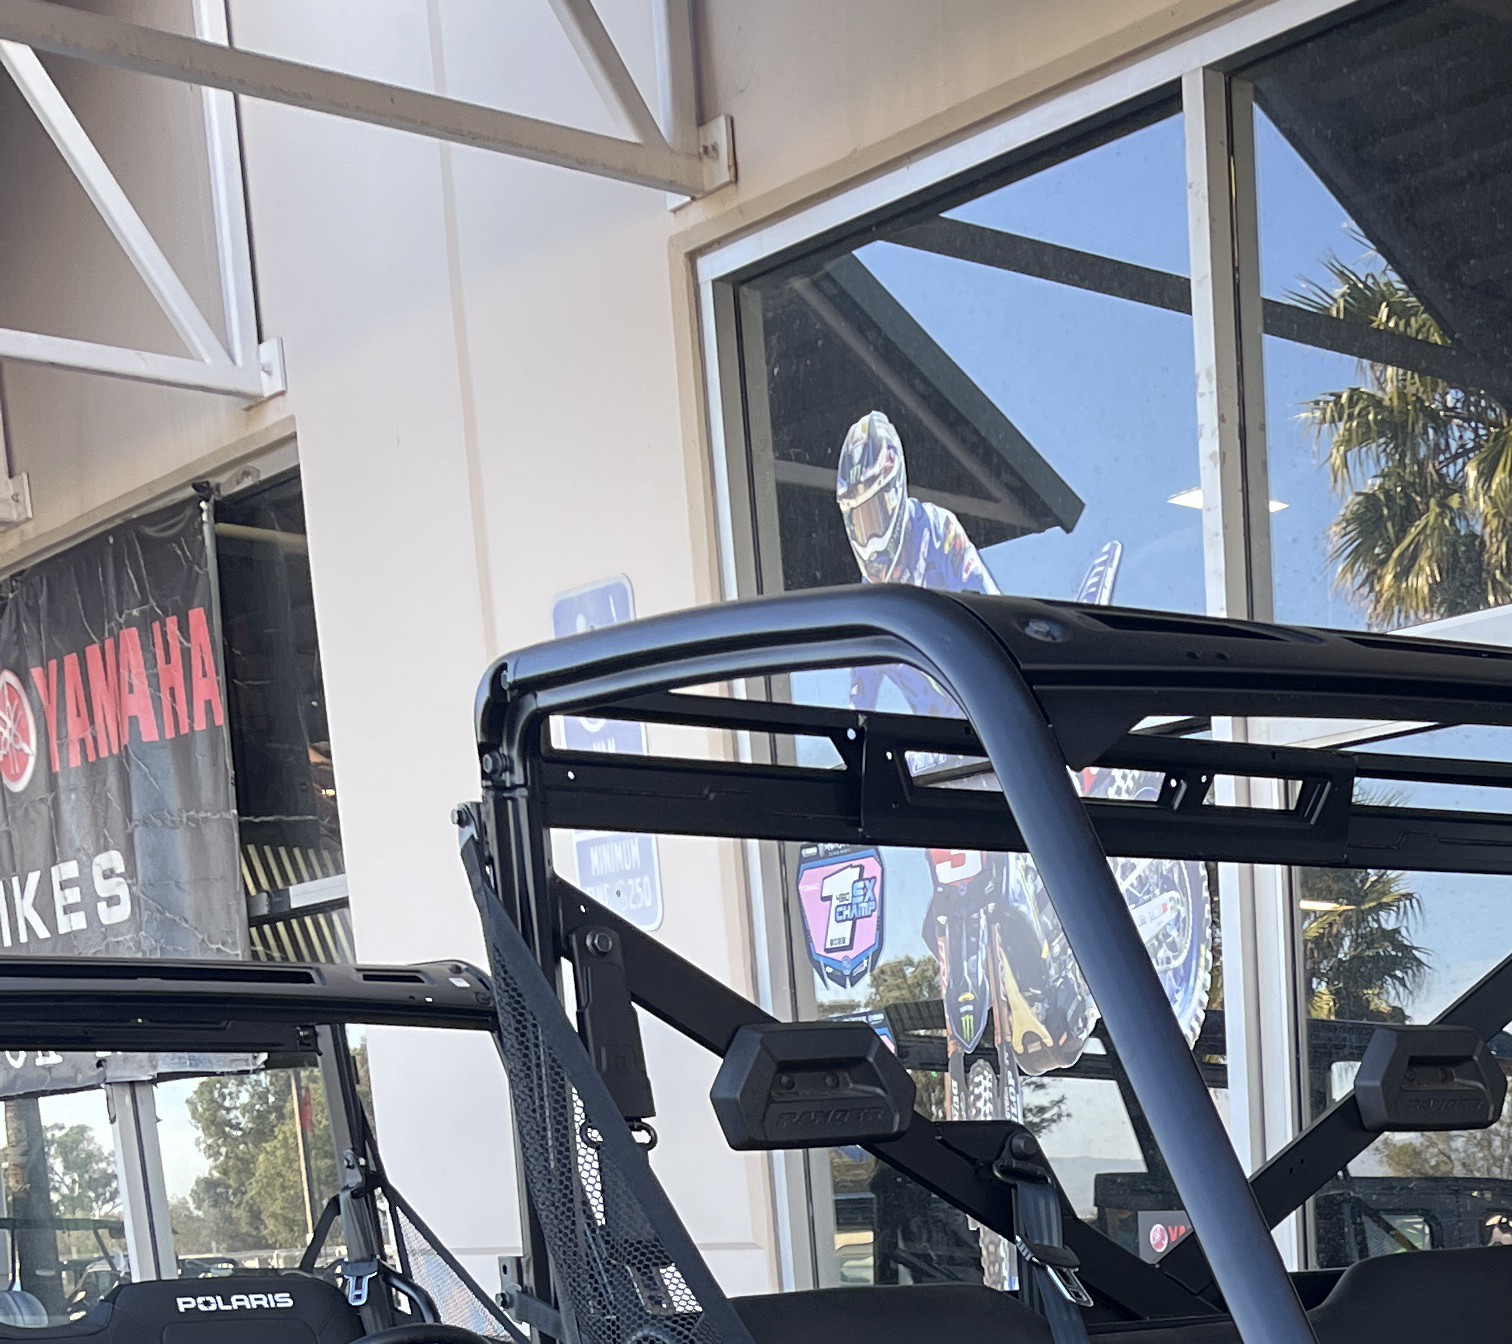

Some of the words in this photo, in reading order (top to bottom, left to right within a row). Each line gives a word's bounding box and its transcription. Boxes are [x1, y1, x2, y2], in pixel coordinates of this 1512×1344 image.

[30, 607, 224, 773] YAMAHA
[590, 837, 641, 876] MINIMUM
[835, 900, 876, 923] CHAMP
[176, 1292, 294, 1313] POLARIS
